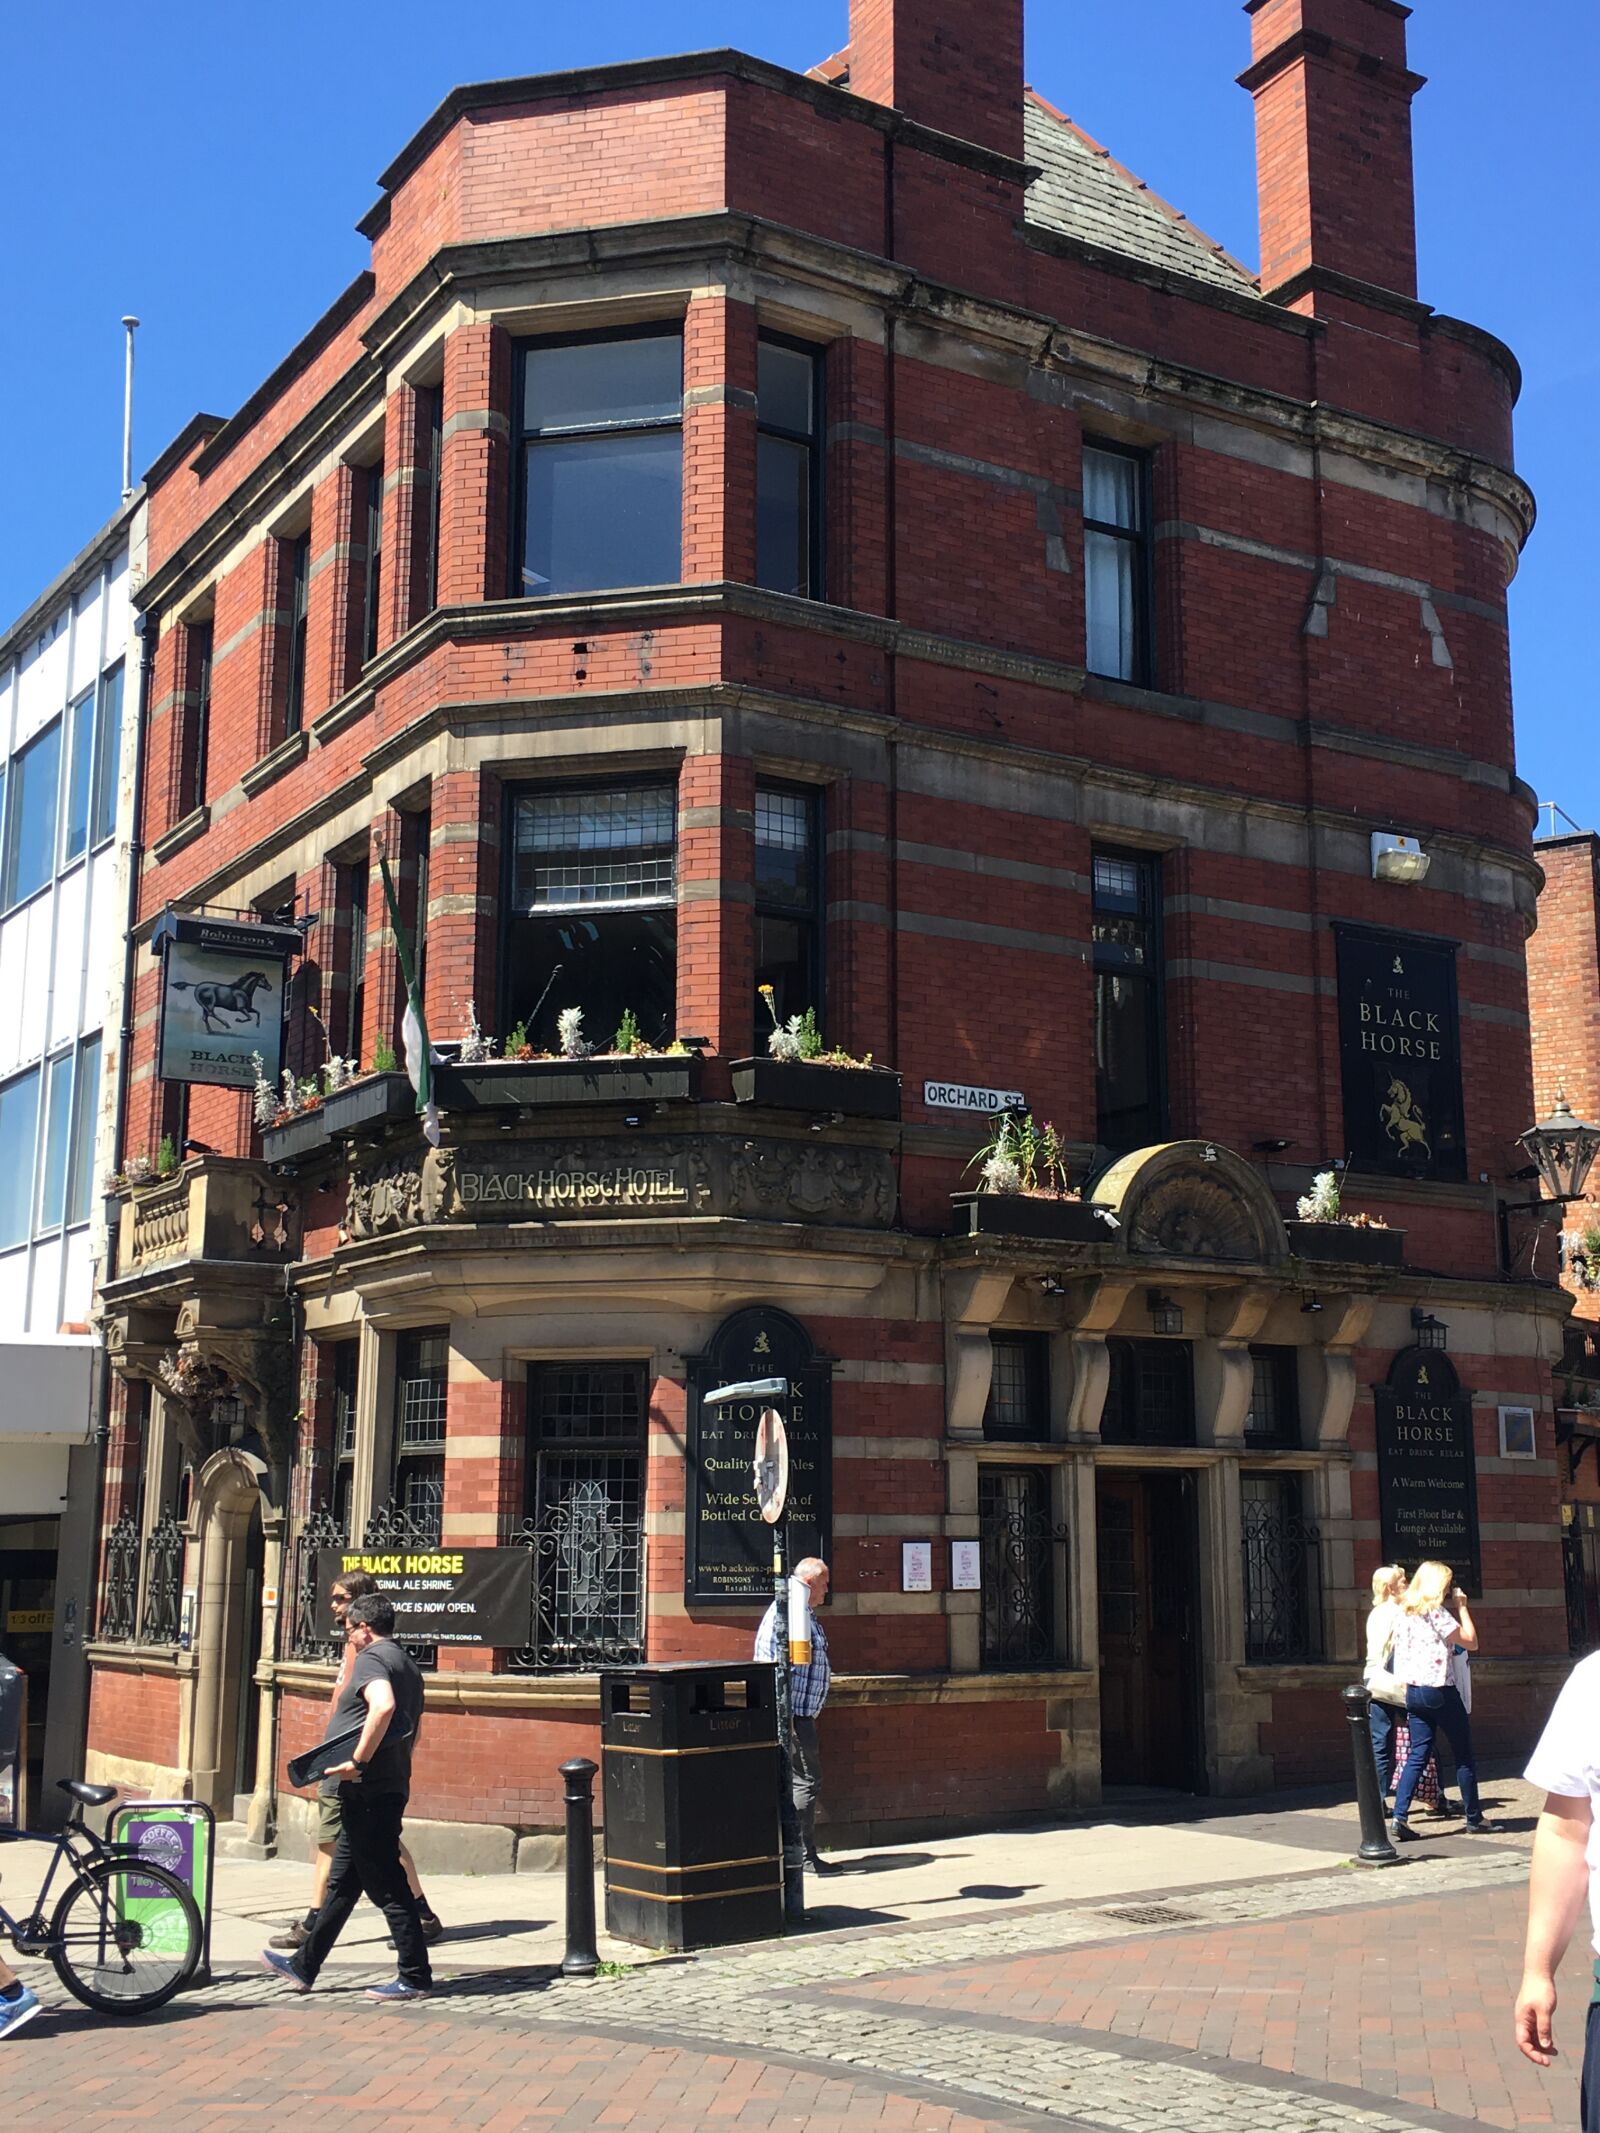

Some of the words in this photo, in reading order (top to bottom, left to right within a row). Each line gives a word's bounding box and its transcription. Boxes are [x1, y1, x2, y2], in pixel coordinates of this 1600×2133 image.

[1387, 987, 1410, 1000] THE
[1360, 1002, 1440, 1032] BLACK
[1361, 1031, 1440, 1060] HORSE
[191, 1050, 252, 1065] BLACK
[189, 1062, 254, 1077] HORSE
[928, 1086, 998, 1109] ORCHARD
[1004, 1095, 1022, 1106] ST
[460, 1172, 534, 1201] BLACK
[536, 1169, 613, 1200] HORSE
[615, 1167, 685, 1197] HOTEL
[748, 1364, 774, 1373] THE
[1415, 1392, 1432, 1400] THE
[717, 1404, 804, 1422] HOE
[1396, 1405, 1452, 1421] BLACK
[702, 1430, 725, 1439] EAT
[786, 1432, 818, 1440] ELAX
[1397, 1426, 1453, 1441] HORSE
[1409, 1448, 1434, 1456] DRINK
[1440, 1449, 1464, 1457] RELAX
[704, 1458, 751, 1473] Quality
[1392, 1478, 1399, 1487] A
[1400, 1478, 1426, 1488] Warm
[1427, 1478, 1465, 1489] Welcome
[706, 1492, 739, 1505] Wide
[801, 1494, 813, 1505] of
[701, 1509, 746, 1521] Bottled
[1397, 1508, 1416, 1519] First
[1418, 1509, 1439, 1519] Floor
[1441, 1509, 1455, 1519] Bar
[1456, 1511, 1464, 1519] &
[1395, 1522, 1426, 1537] Lounge
[1428, 1523, 1466, 1534] Available
[1418, 1539, 1427, 1547] to
[1429, 1537, 1448, 1548] Hire
[342, 1556, 361, 1573] THE
[363, 1556, 401, 1574] BLACK
[406, 1555, 464, 1574] HORSE
[376, 1580, 401, 1590] GINAL
[403, 1580, 420, 1590] ALE
[421, 1580, 454, 1591] SHRINE.
[391, 1602, 413, 1613] RACE
[414, 1603, 422, 1613] IS
[424, 1602, 445, 1613] NOW
[448, 1603, 477, 1614] OPEN.
[28, 1612, 46, 1625] off
[709, 1717, 741, 1731] Litter
[142, 1827, 179, 1845] COFFEE
